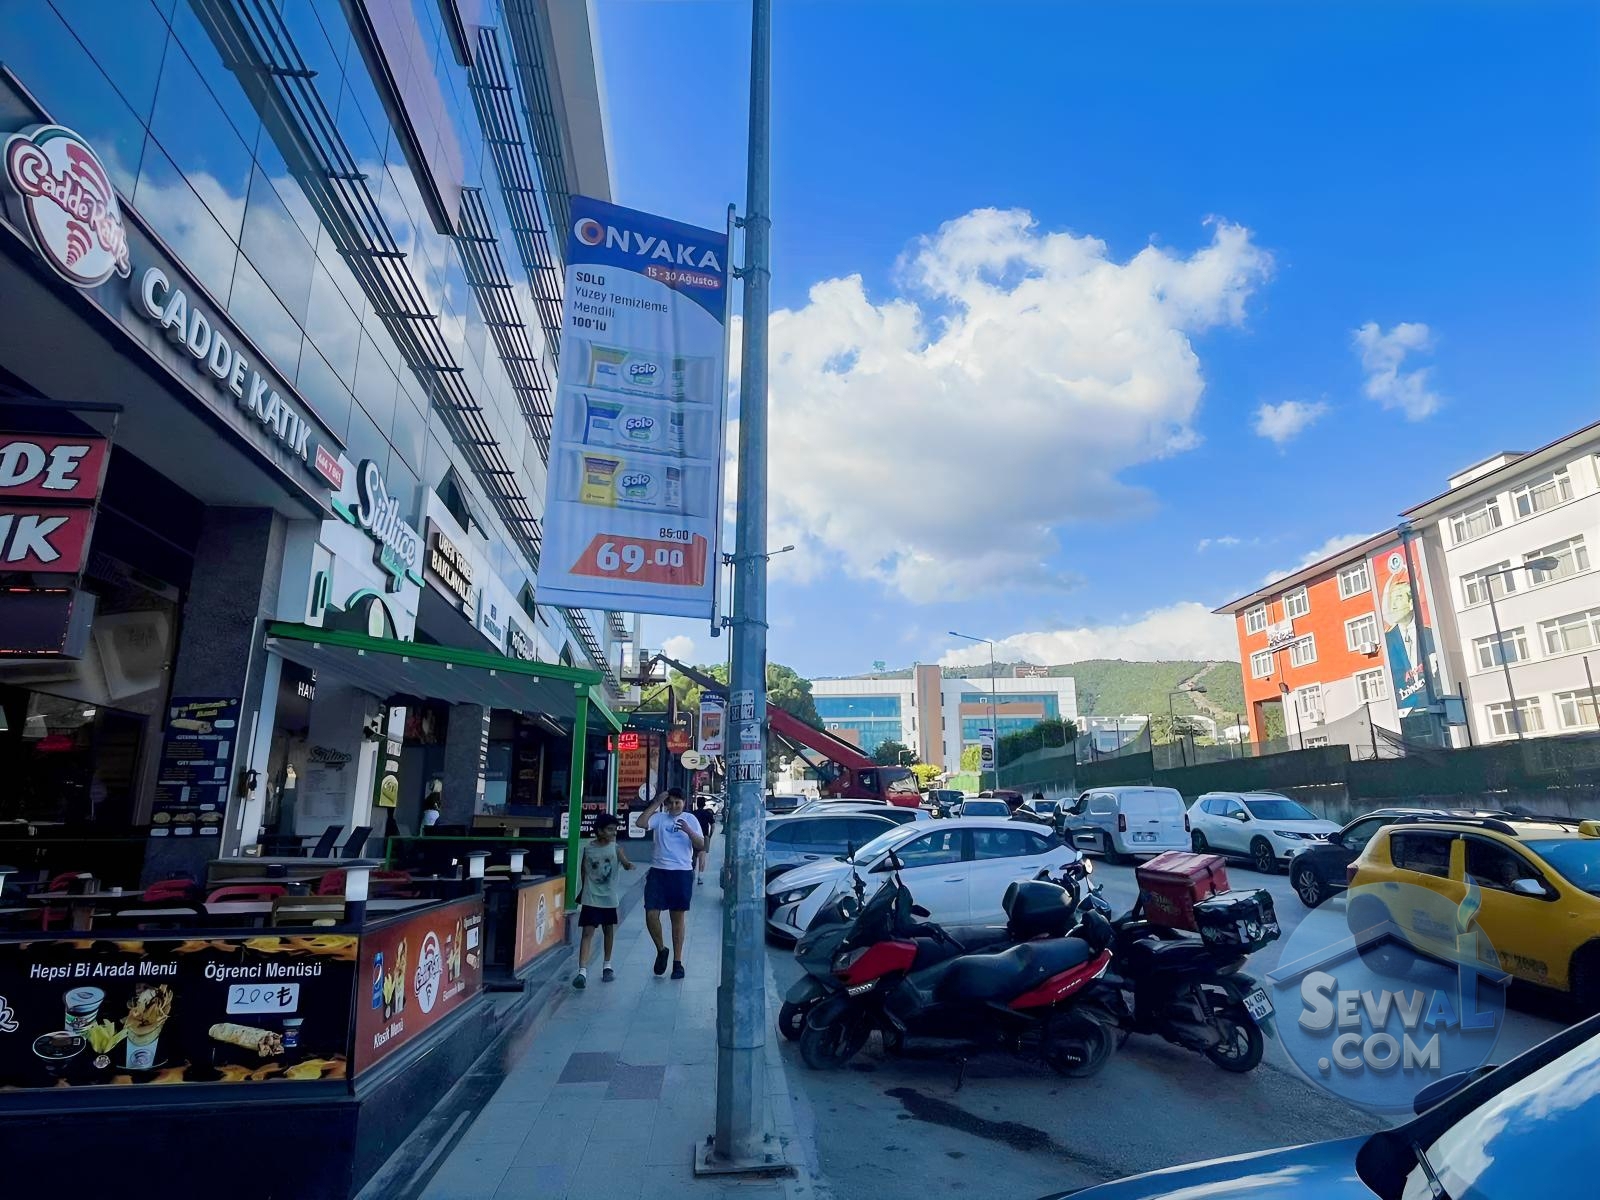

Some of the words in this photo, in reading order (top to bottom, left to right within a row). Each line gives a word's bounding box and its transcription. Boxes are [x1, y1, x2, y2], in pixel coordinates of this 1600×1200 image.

[574, 217, 722, 272] ONYAKA
[576, 272, 605, 286] SOLO
[647, 267, 657, 278] 15
[665, 270, 676, 281] 30
[678, 270, 719, 287] Ağustos
[573, 301, 615, 318] Mendili
[610, 293, 668, 313] Temizleme
[142, 267, 249, 398] CADDE
[247, 371, 313, 461] KATIK
[30, 964, 71, 981] Hepsi
[75, 963, 90, 977] Bi
[93, 962, 135, 977] Arada
[139, 961, 177, 976] Menü
[204, 961, 262, 982] Öğrenci
[266, 962, 322, 977] Menüsü
